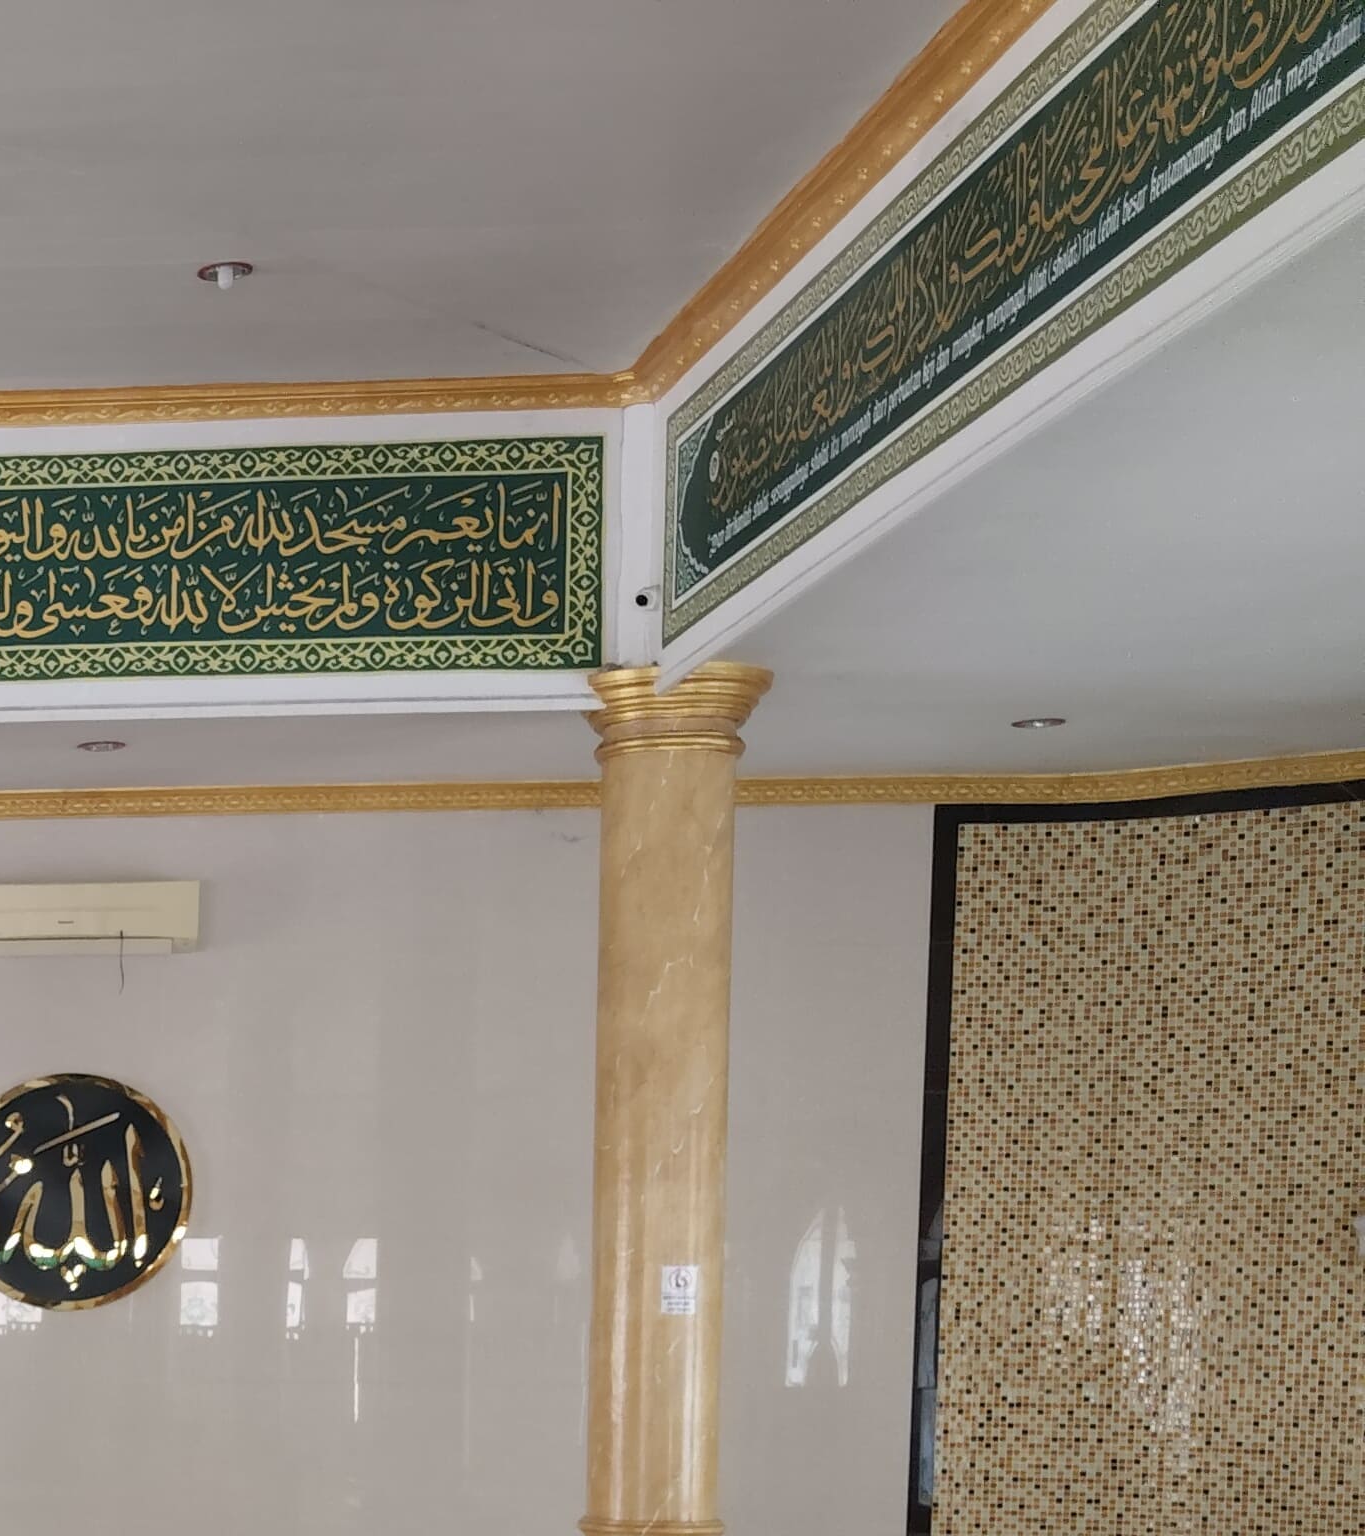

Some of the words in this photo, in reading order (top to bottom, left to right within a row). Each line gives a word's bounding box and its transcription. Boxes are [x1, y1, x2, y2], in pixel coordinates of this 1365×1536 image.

[841, 404, 872, 452] mencegah
[872, 391, 888, 425] dari
[887, 368, 922, 422] perbuatan
[922, 351, 936, 390] keji
[936, 343, 951, 375] dan
[1081, 227, 1097, 259] itu
[1097, 197, 1121, 245] lebih
[1121, 182, 1148, 226] besar
[1225, 106, 1248, 143] dan
[1248, 66, 1283, 131] Allah
